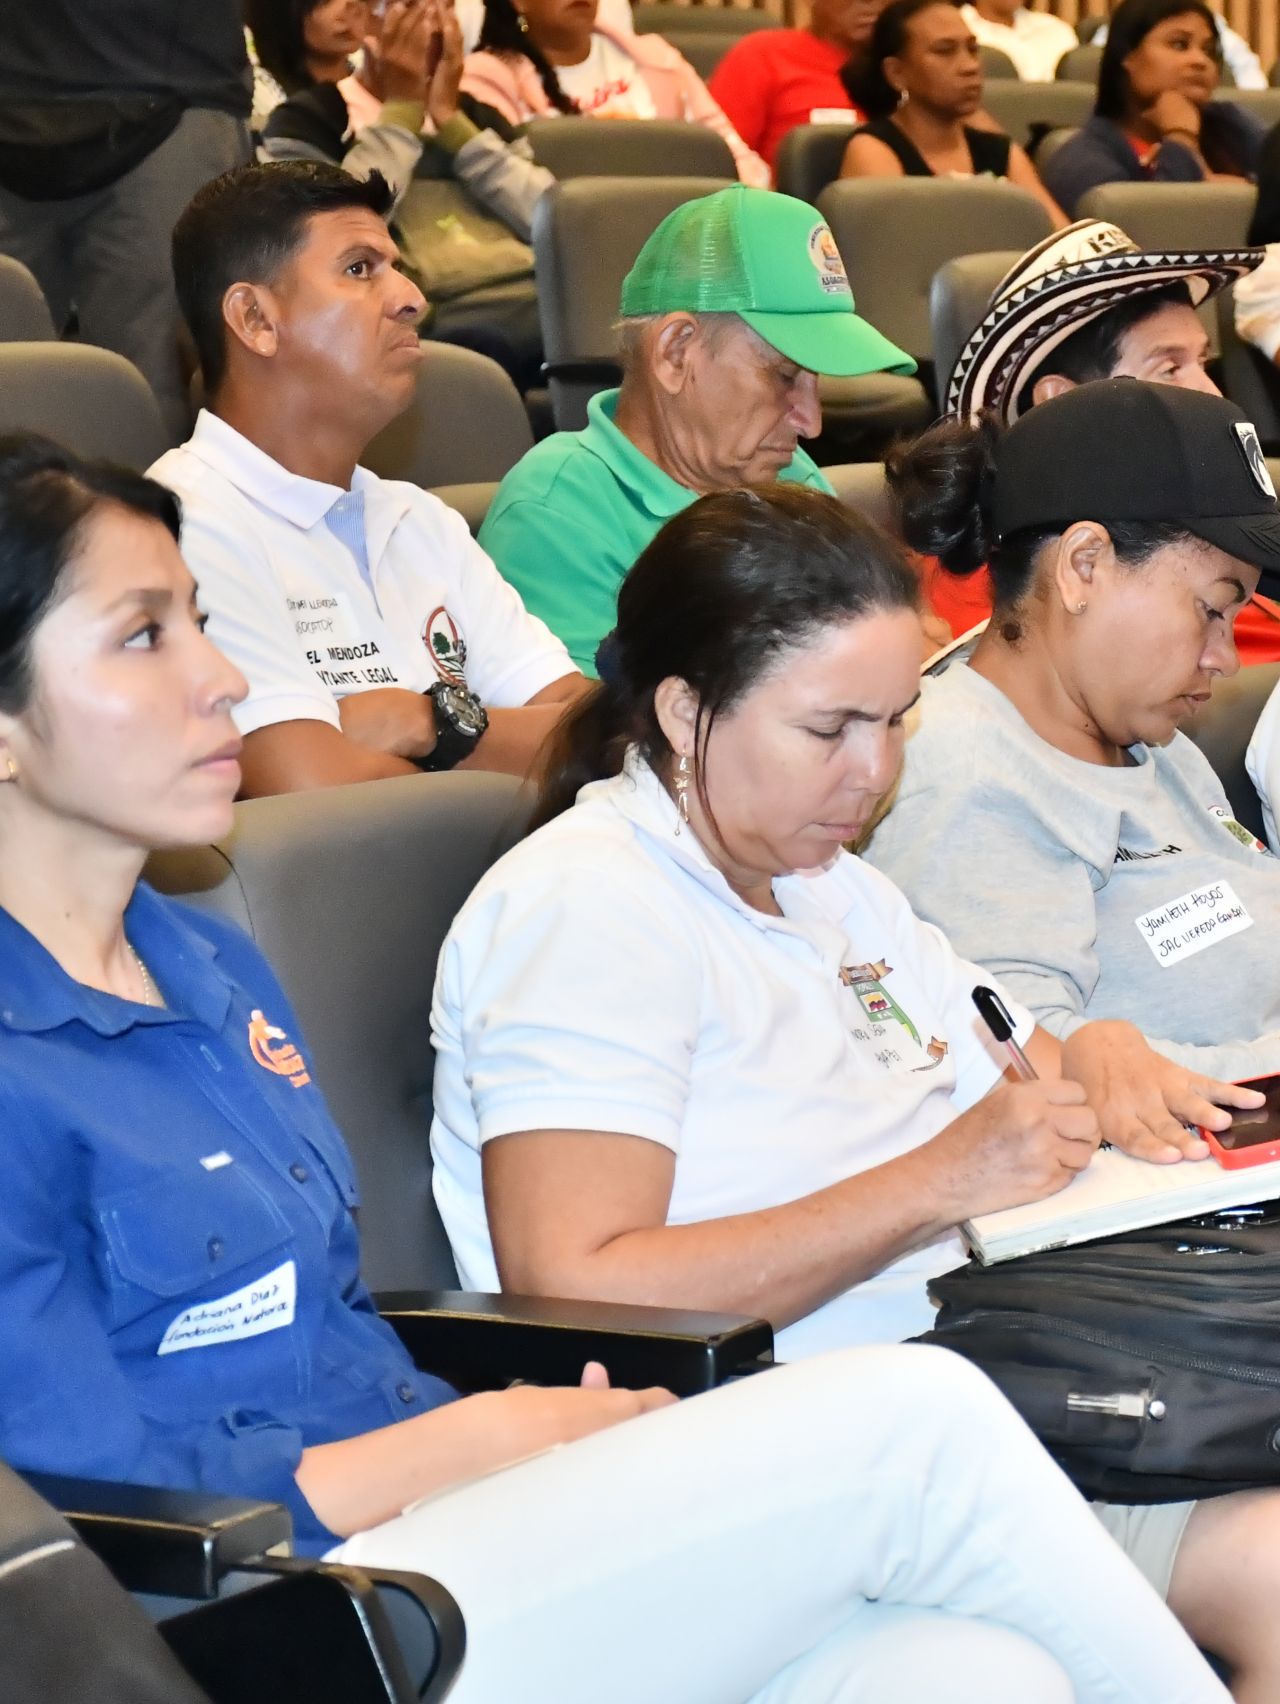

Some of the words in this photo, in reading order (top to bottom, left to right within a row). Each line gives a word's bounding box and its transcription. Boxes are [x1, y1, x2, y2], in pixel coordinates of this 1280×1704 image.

[327, 641, 380, 660] MENDOZA
[361, 666, 398, 683] LEGAL
[1158, 937, 1182, 957] JAC
